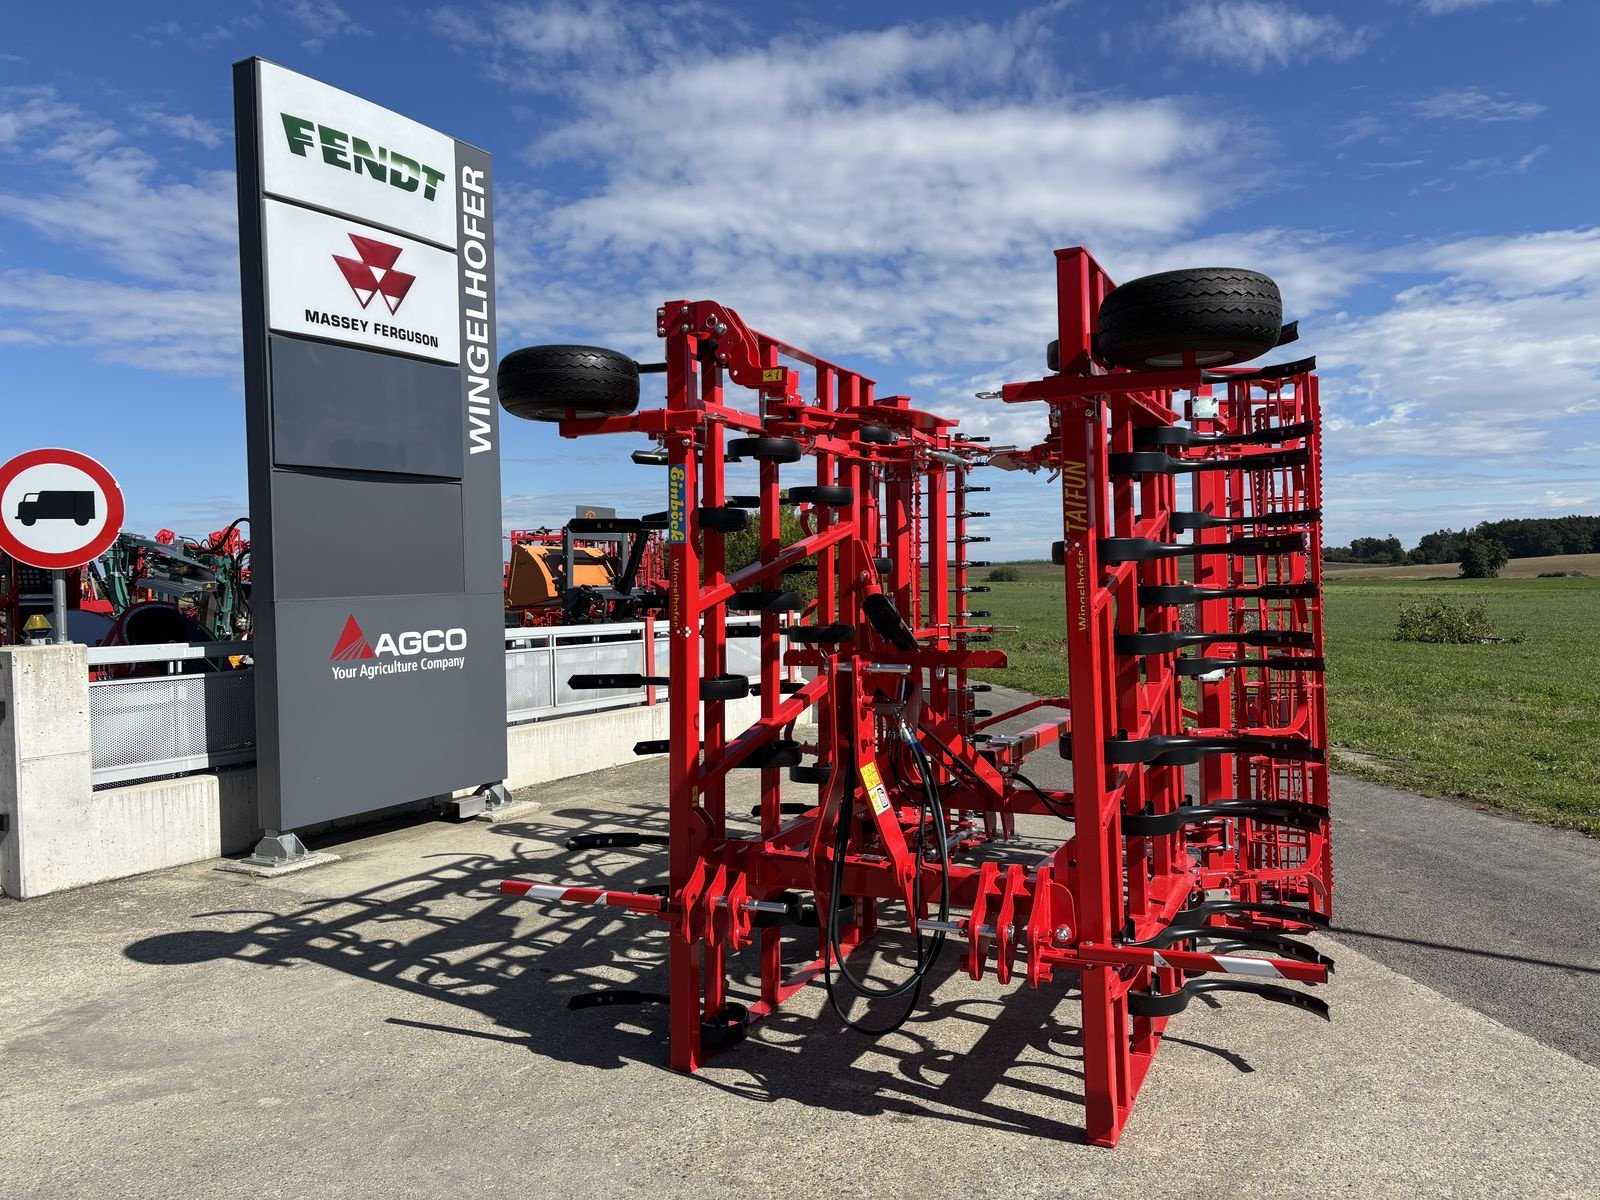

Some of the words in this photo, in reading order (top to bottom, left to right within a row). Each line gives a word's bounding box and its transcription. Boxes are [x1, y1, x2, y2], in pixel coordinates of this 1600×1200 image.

[280, 112, 446, 202] FENDT
[305, 309, 369, 333] MASSEY
[373, 322, 439, 348] FERGUSON
[462, 165, 492, 455] WINGELHOFER
[670, 466, 685, 542] Einböck
[1064, 460, 1088, 532] TAIFUN
[331, 666, 357, 680] Your
[360, 661, 418, 680] Agriculture
[420, 656, 465, 671] Company
[374, 627, 467, 657] AGCO
